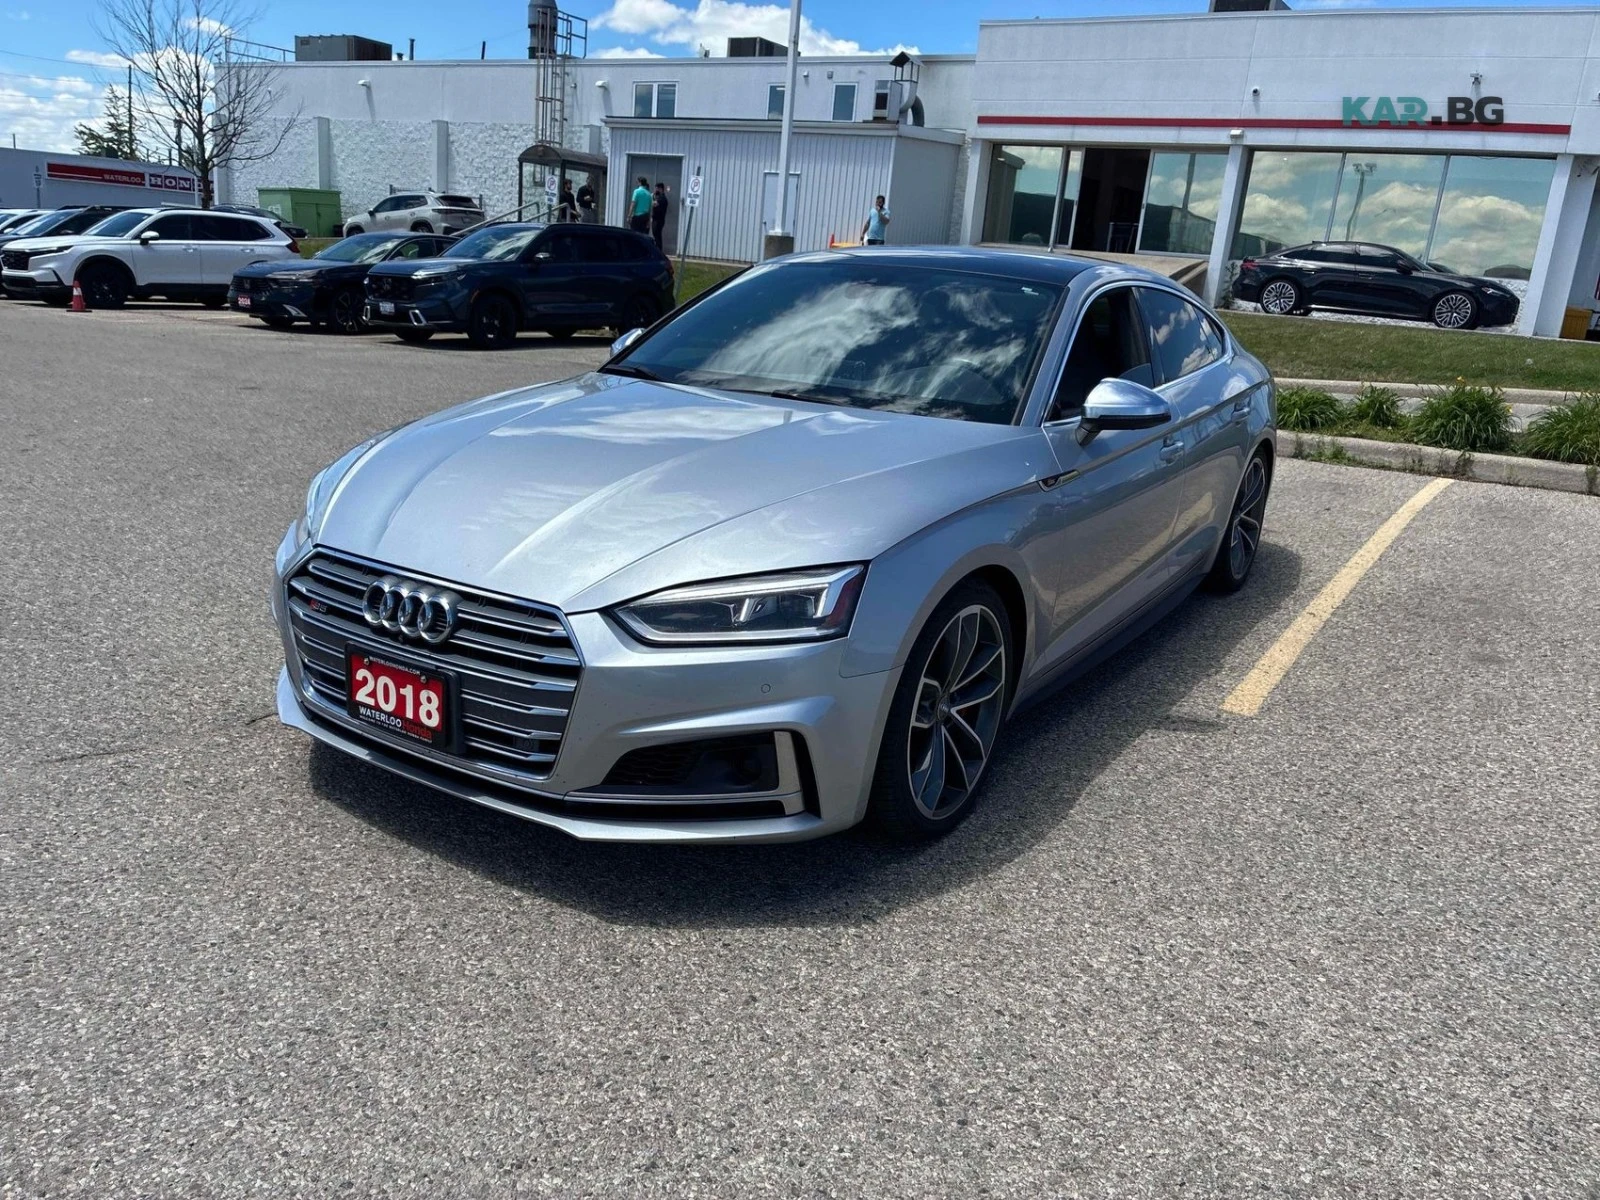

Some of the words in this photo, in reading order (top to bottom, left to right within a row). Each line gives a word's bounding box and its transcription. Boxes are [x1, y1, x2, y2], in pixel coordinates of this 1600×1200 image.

[103, 174, 141, 183] WATERLOO
[150, 177, 214, 189] HOND
[355, 668, 440, 728] 2018
[359, 706, 402, 727] WATERLOO
[403, 720, 433, 739] Honda
